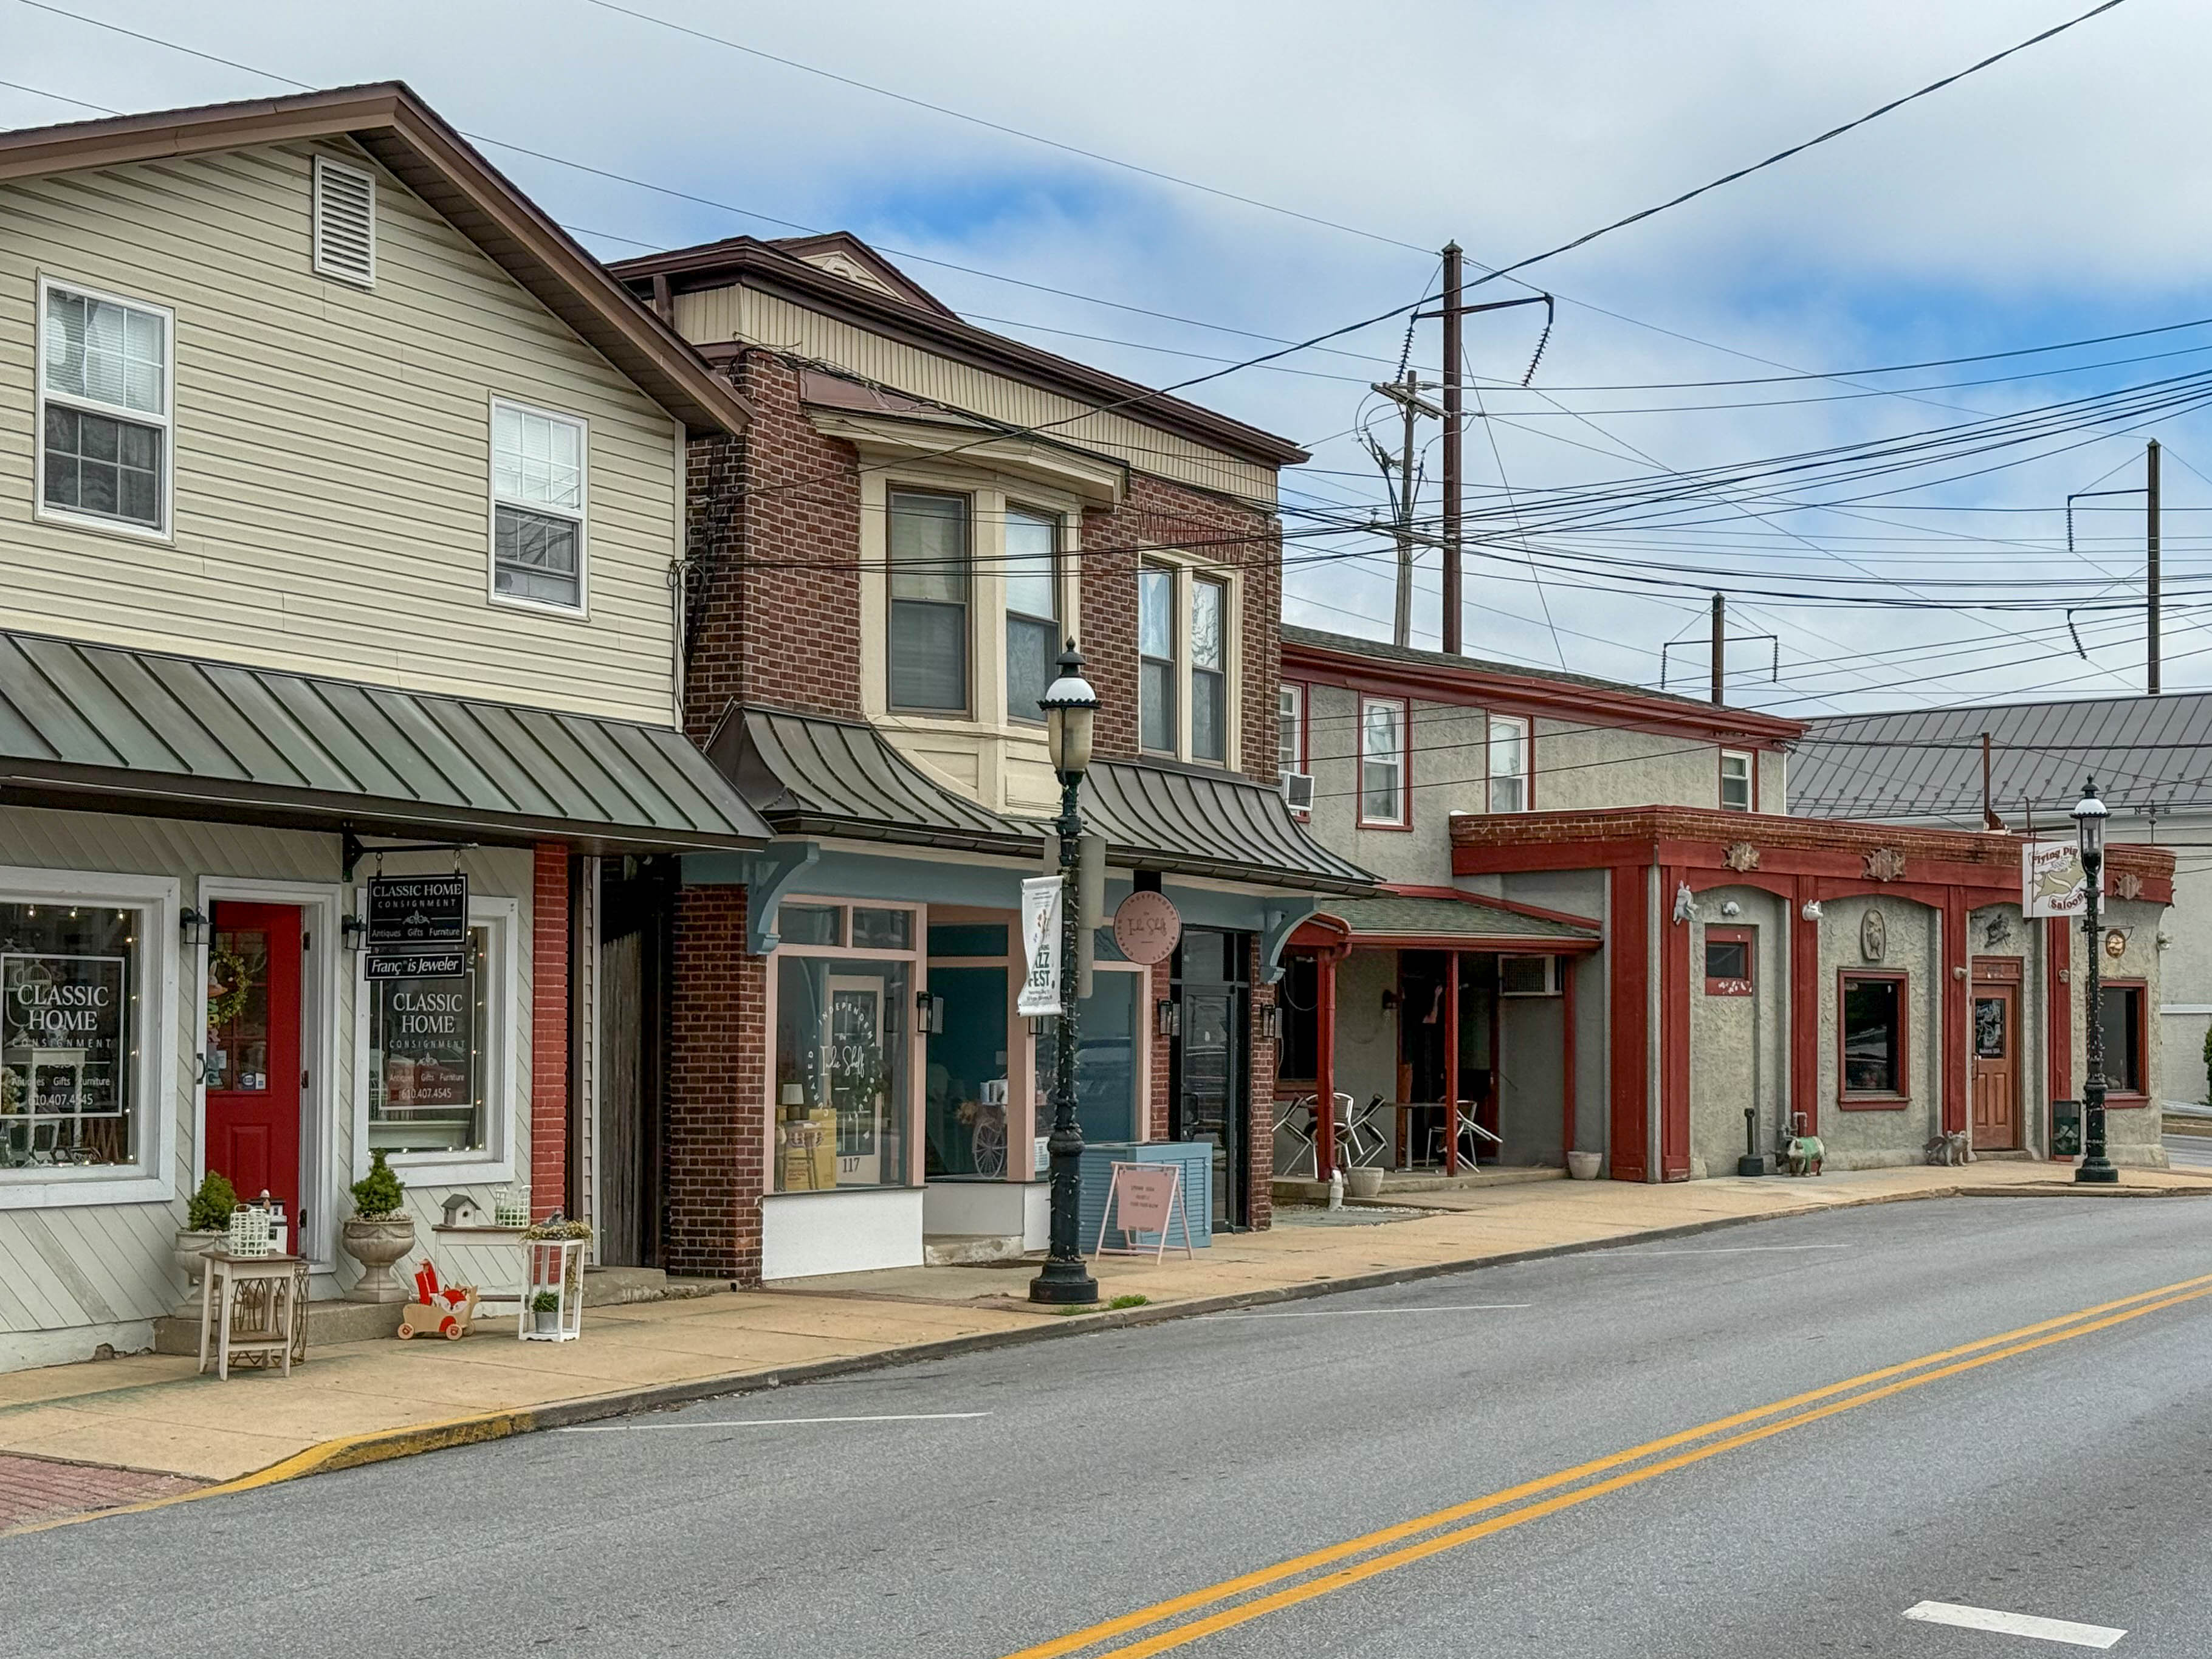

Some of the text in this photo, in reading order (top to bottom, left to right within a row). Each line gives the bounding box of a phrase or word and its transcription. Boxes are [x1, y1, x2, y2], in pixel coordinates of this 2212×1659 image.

[2032, 847, 2078, 864] Flying Pig
[373, 884, 462, 897] CLASSIC HOME
[378, 899, 456, 908] CONSIGNMENT
[2051, 893, 2083, 909] Saloon
[372, 927, 460, 938] Antiques Gifts Furniture
[372, 956, 459, 975] Françis Jeweler
[18, 984, 109, 1006] CLASSIC
[393, 993, 463, 1012] CLASSIC
[29, 1010, 98, 1031] HOME
[402, 1015, 455, 1033] HOME
[818, 1002, 876, 1047] INDEPENDENT
[12, 1038, 111, 1048] CONSIGNMENT
[390, 1040, 465, 1049] CONSIGNMENT
[11, 1076, 111, 1087] Antiqes Gifts urniture
[29, 1094, 93, 1105] 610.407.445
[402, 1088, 452, 1099] 610.407.4545
[843, 1157, 860, 1173] 117
